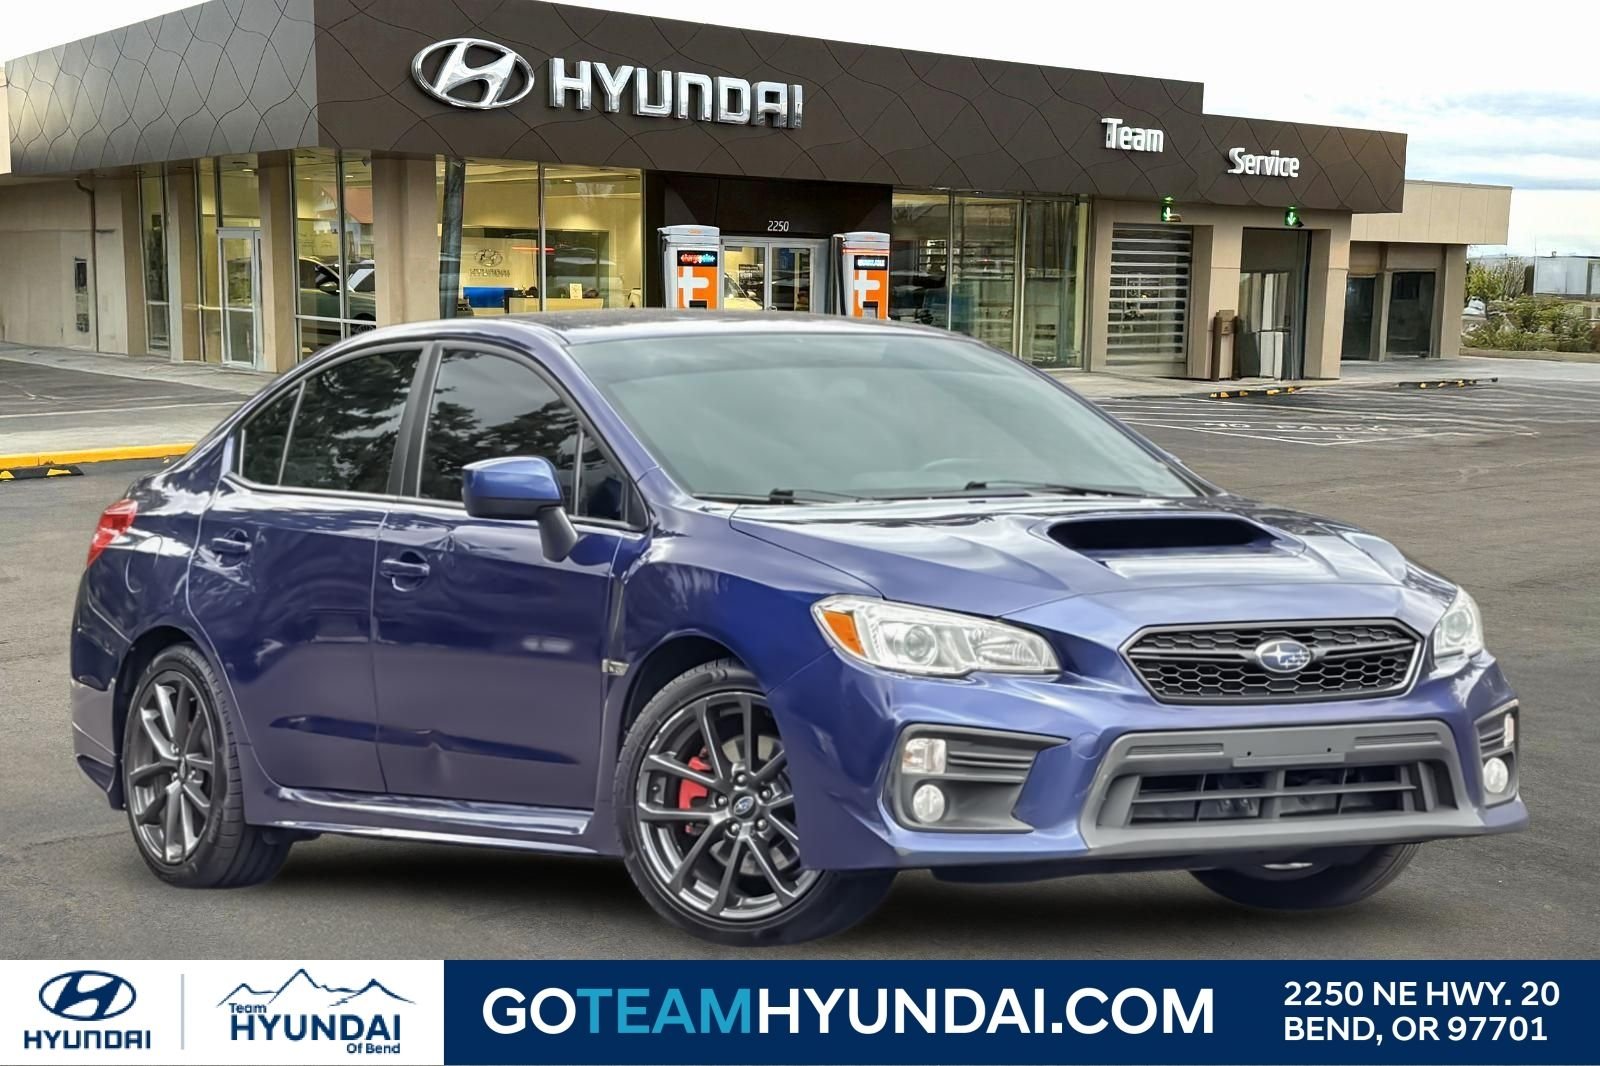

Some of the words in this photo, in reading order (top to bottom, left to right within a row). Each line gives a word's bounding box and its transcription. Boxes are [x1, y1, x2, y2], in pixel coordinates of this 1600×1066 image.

[548, 56, 803, 129] HYUNDAI
[1101, 117, 1164, 152] Team
[1227, 147, 1300, 178] Service
[767, 220, 790, 232] 2250
